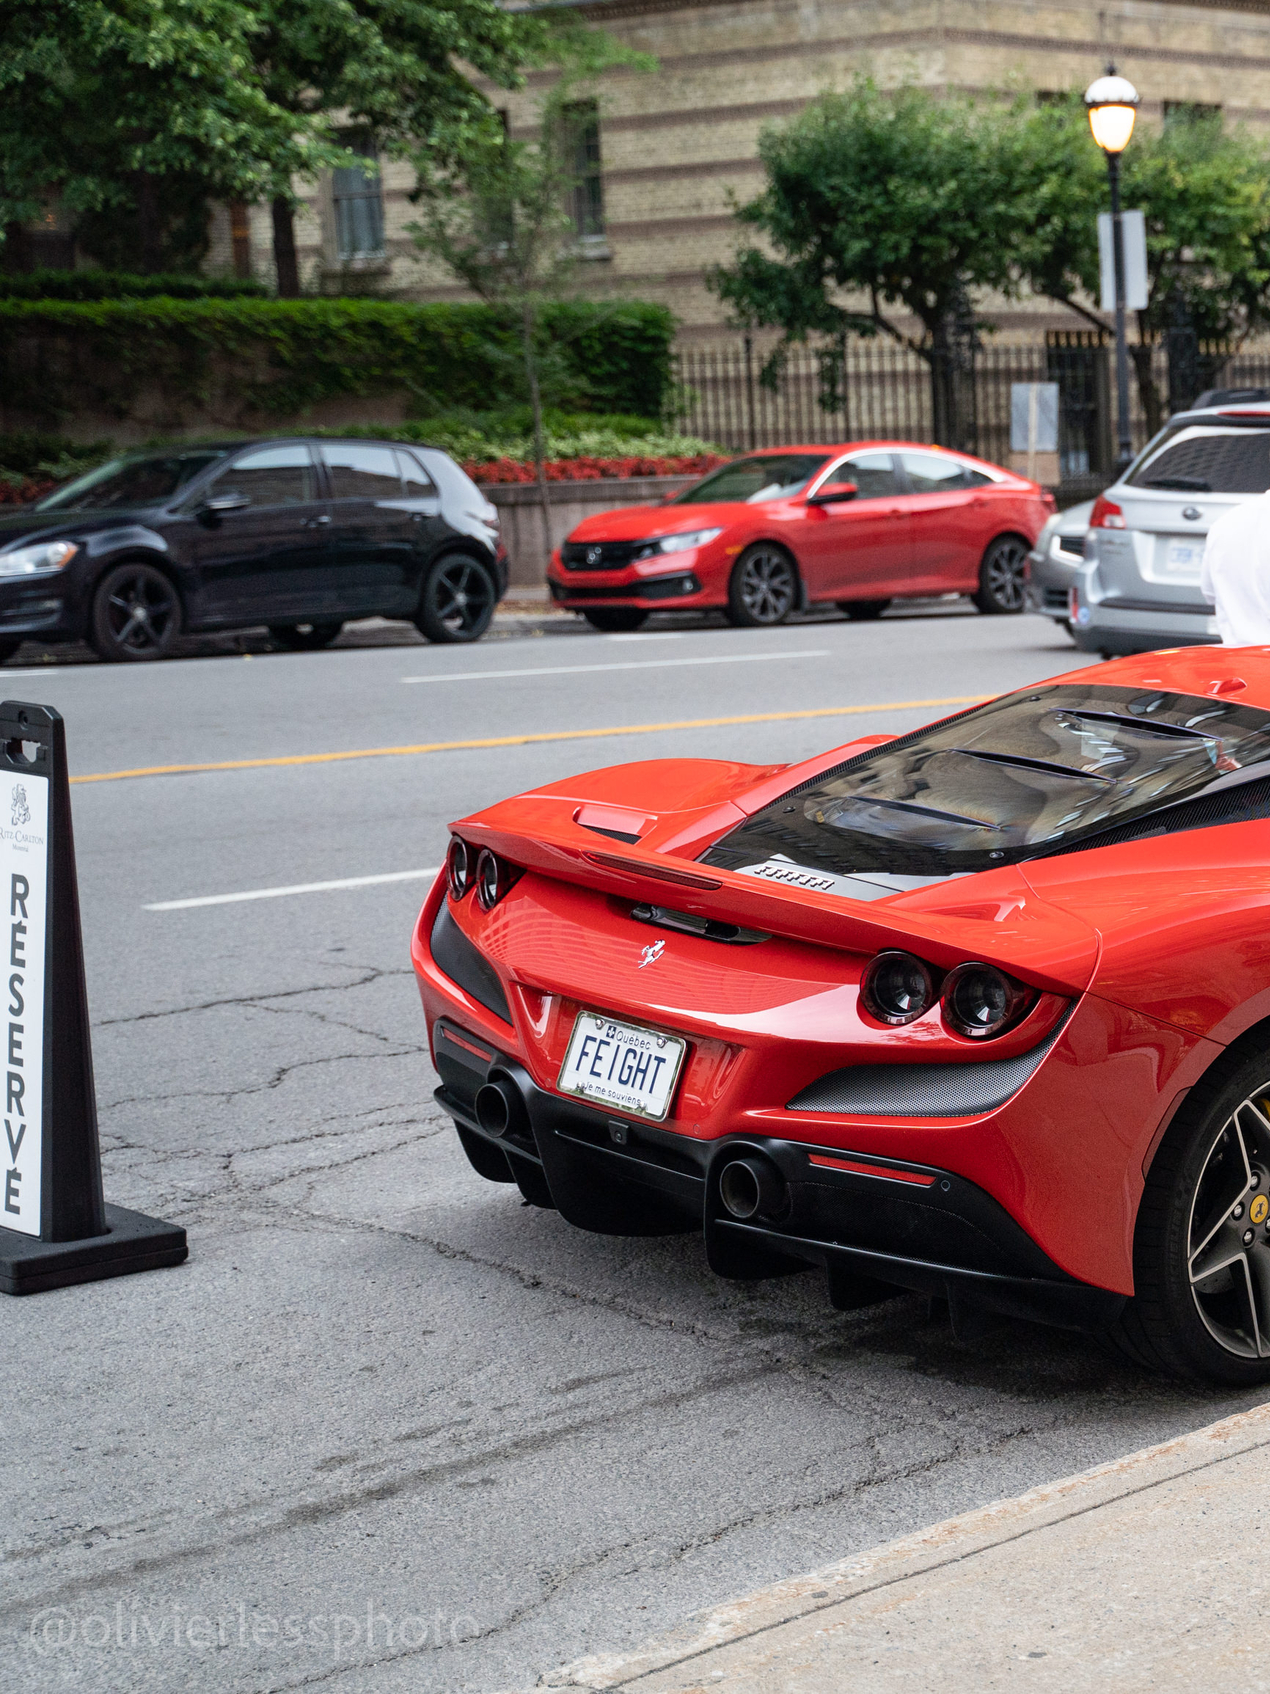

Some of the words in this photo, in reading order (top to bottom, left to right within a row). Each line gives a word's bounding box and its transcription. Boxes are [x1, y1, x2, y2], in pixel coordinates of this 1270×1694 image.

[616, 1030, 651, 1050] Québec
[575, 1034, 667, 1094] FEIGHT
[594, 1086, 606, 1095] me
